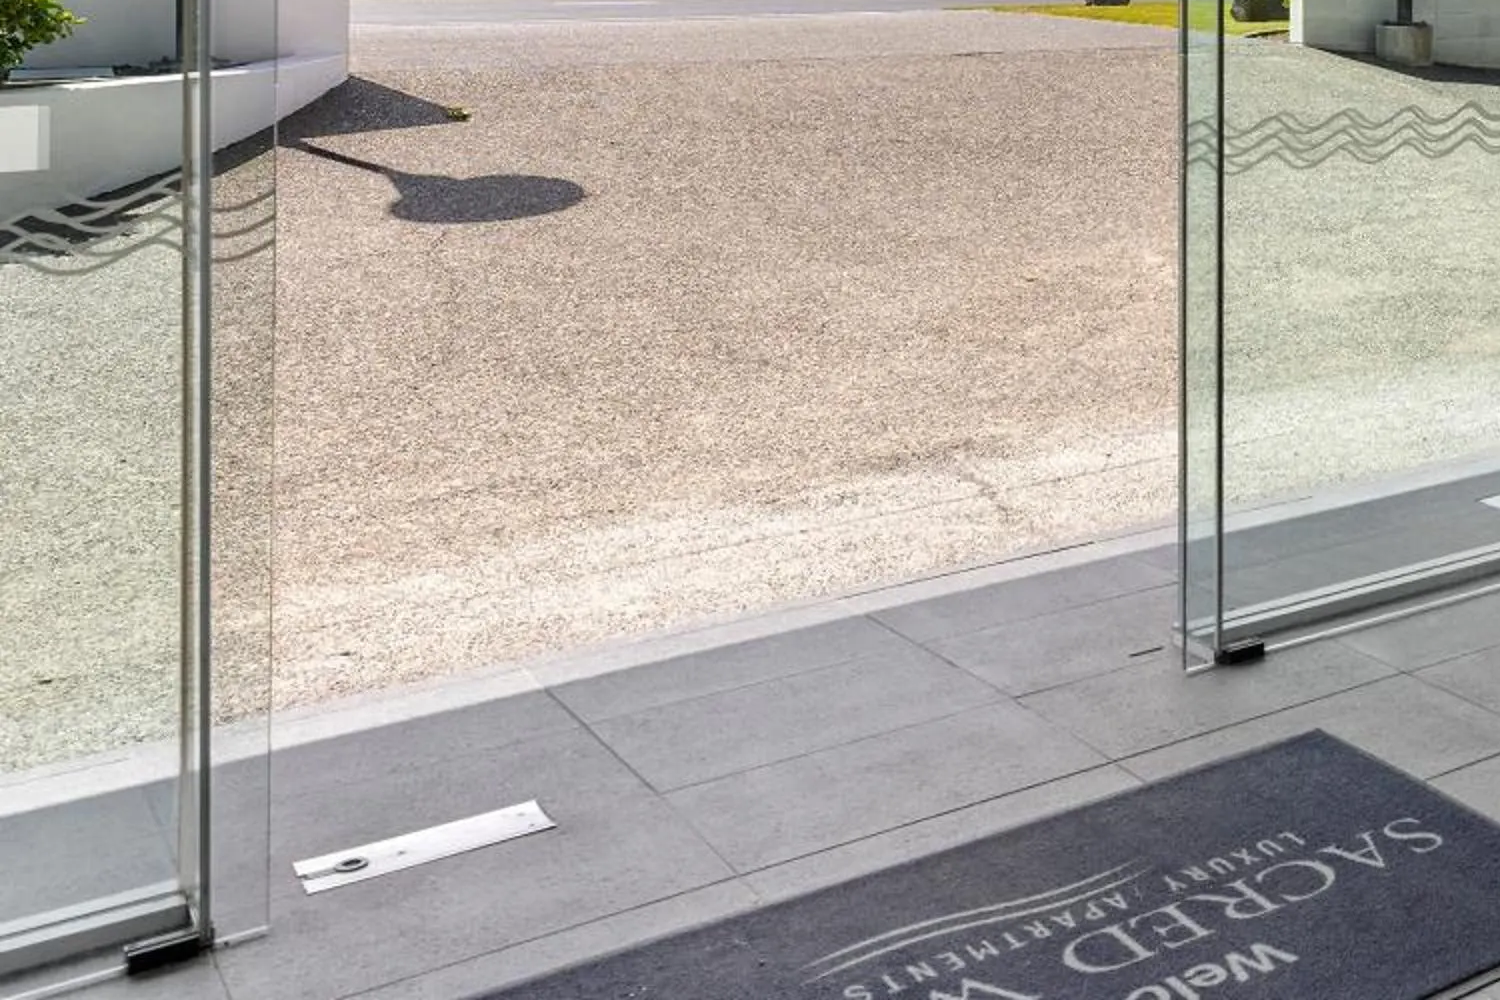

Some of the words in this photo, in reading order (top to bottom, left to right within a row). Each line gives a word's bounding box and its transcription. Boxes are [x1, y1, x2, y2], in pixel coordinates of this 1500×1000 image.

[1063, 817, 1443, 973] SACRED
[1163, 831, 1306, 893] LUXURY
[843, 896, 1129, 1000] APARTMENTS
